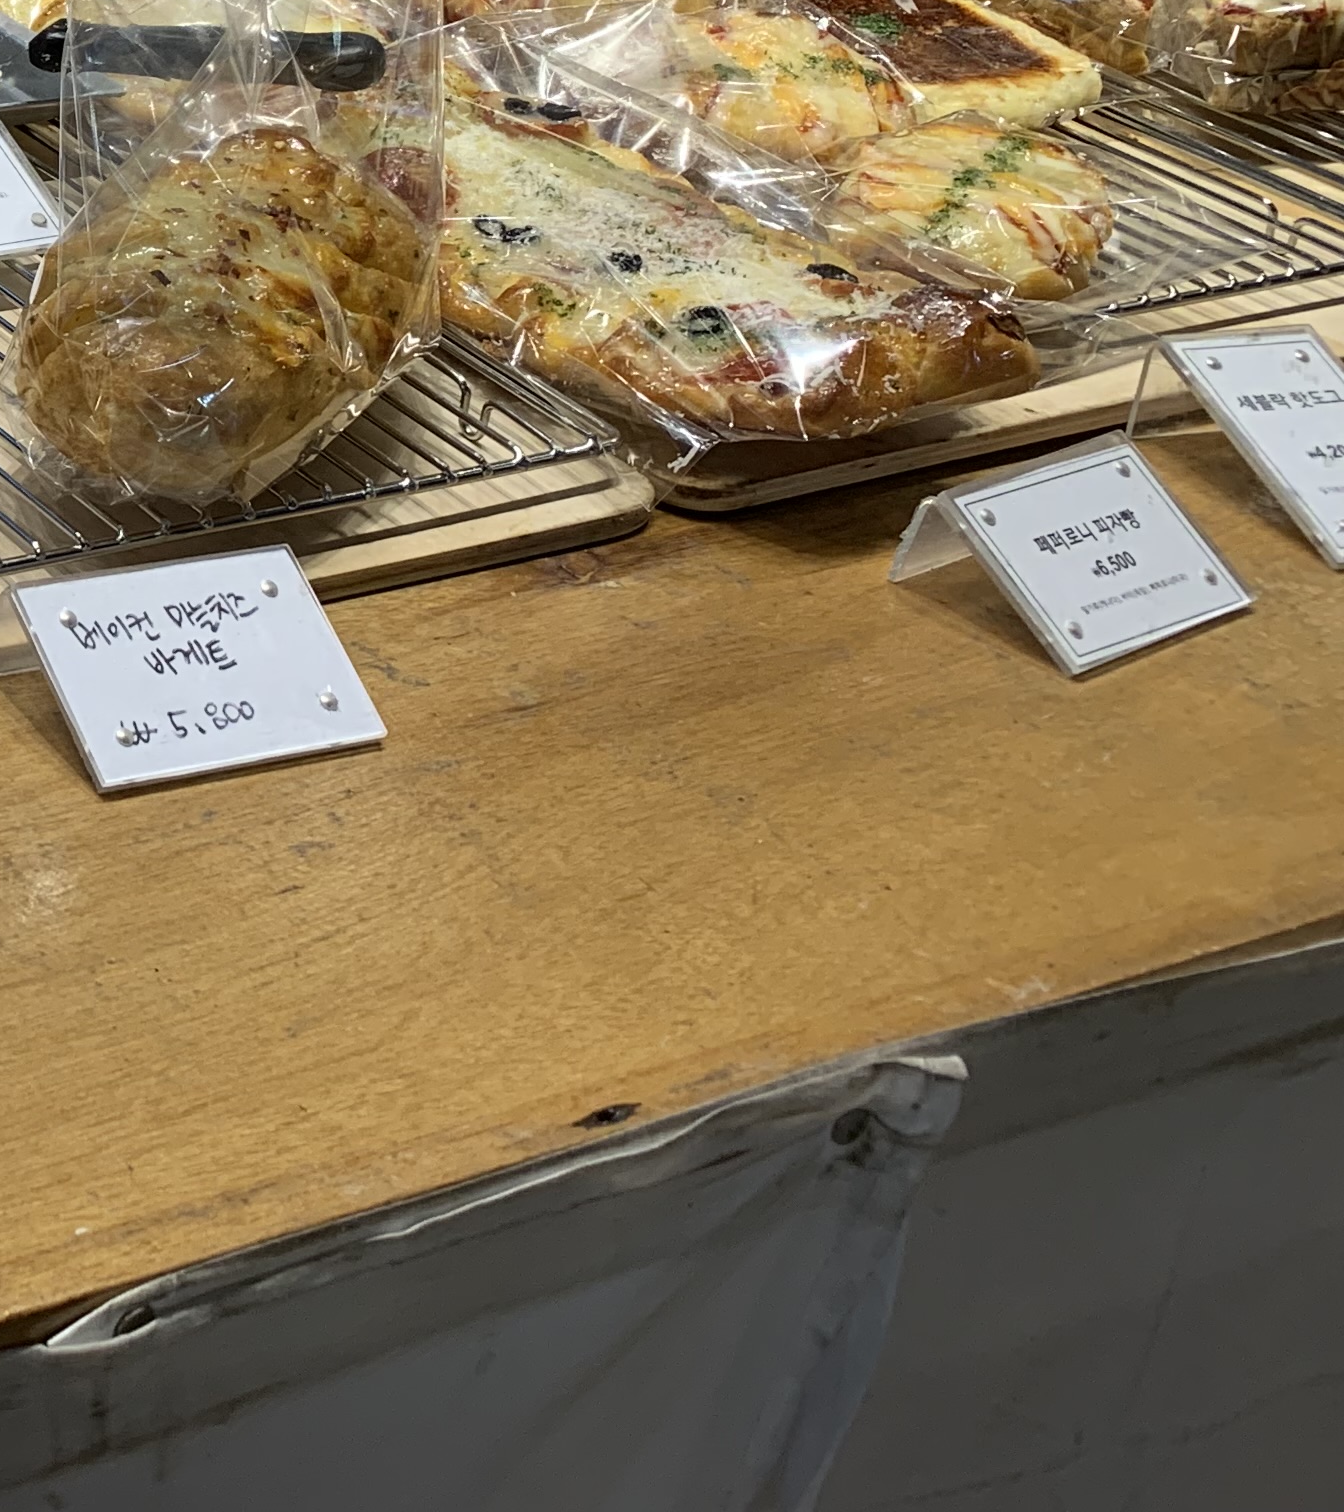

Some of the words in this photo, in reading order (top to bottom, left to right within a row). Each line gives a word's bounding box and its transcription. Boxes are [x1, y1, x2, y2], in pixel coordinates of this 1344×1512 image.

[1289, 390, 1344, 408] 핫도그
[1033, 524, 1099, 556] 페퍼로니
[1091, 509, 1141, 535] 피자빵
[1091, 550, 1137, 578] ₩6,500
[69, 610, 160, 651] 베이컨
[164, 591, 259, 633] 마늘치즈
[144, 639, 237, 676] 바게트
